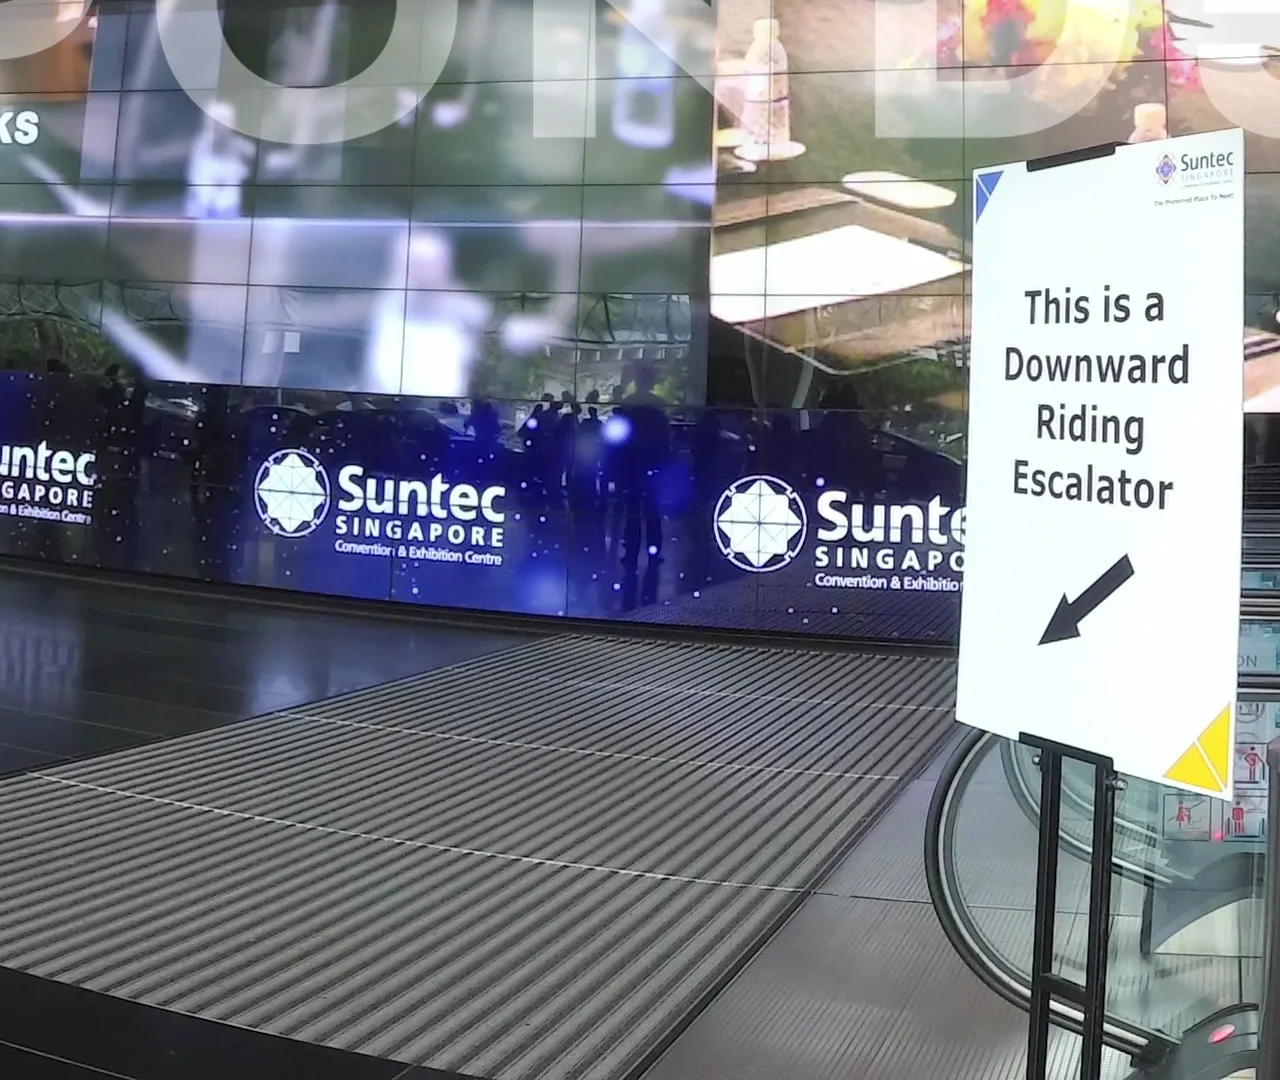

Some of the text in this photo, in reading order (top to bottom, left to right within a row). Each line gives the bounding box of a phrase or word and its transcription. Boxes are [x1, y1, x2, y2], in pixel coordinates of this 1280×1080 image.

[1180, 151, 1234, 172] Suntec
[1024, 284, 1165, 325] This is a
[1005, 343, 1190, 385] Downward
[1036, 403, 1145, 456] Riding
[337, 465, 506, 524] Suntec
[1013, 460, 1174, 511] Escalator
[335, 515, 504, 548] SINGAPORE
[335, 540, 503, 567] Convention & Exhibition Centre
[815, 572, 887, 590] Convention
[890, 574, 901, 590] &
